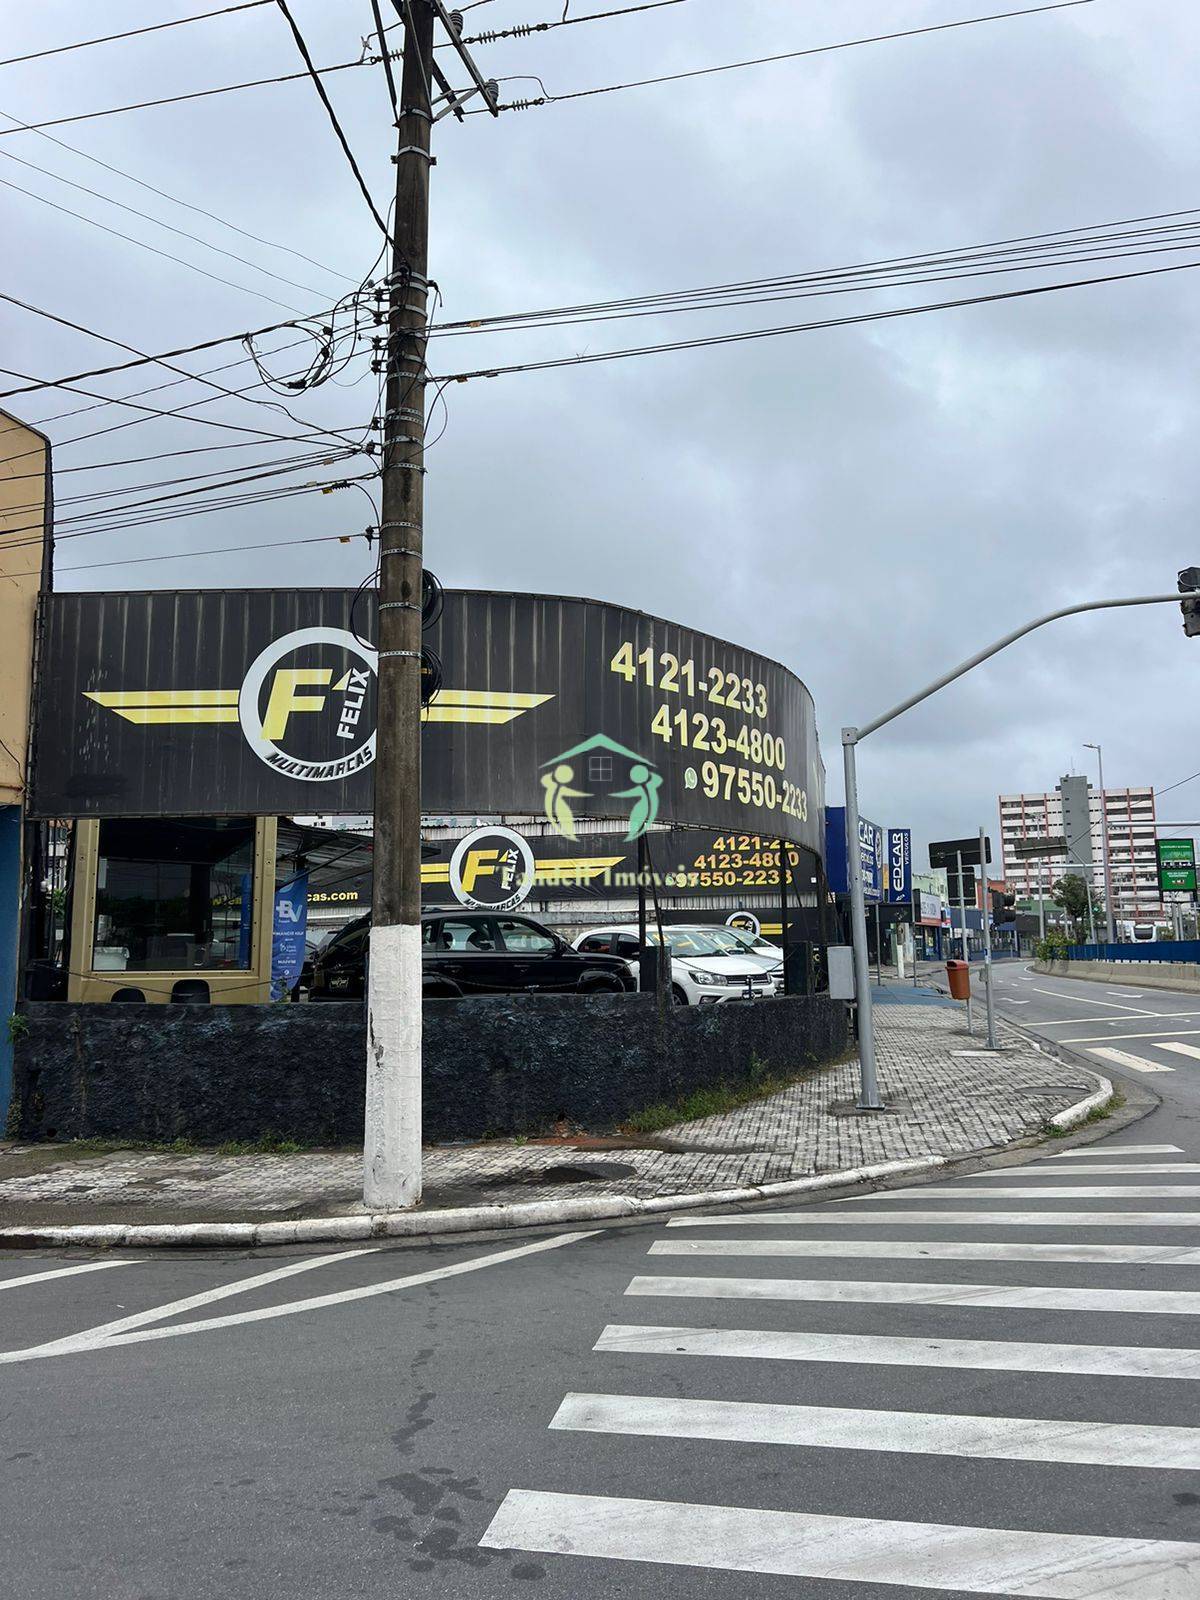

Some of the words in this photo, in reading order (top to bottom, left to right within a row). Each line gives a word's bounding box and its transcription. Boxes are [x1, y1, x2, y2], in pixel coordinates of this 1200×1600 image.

[336, 667, 371, 740] FELIX
[610, 641, 768, 719] 4121-2233
[264, 745, 373, 779] MULTIMARCAS
[651, 704, 786, 771] 4123-4800
[701, 760, 807, 823] 97550-2233
[892, 832, 904, 892] EDCAR
